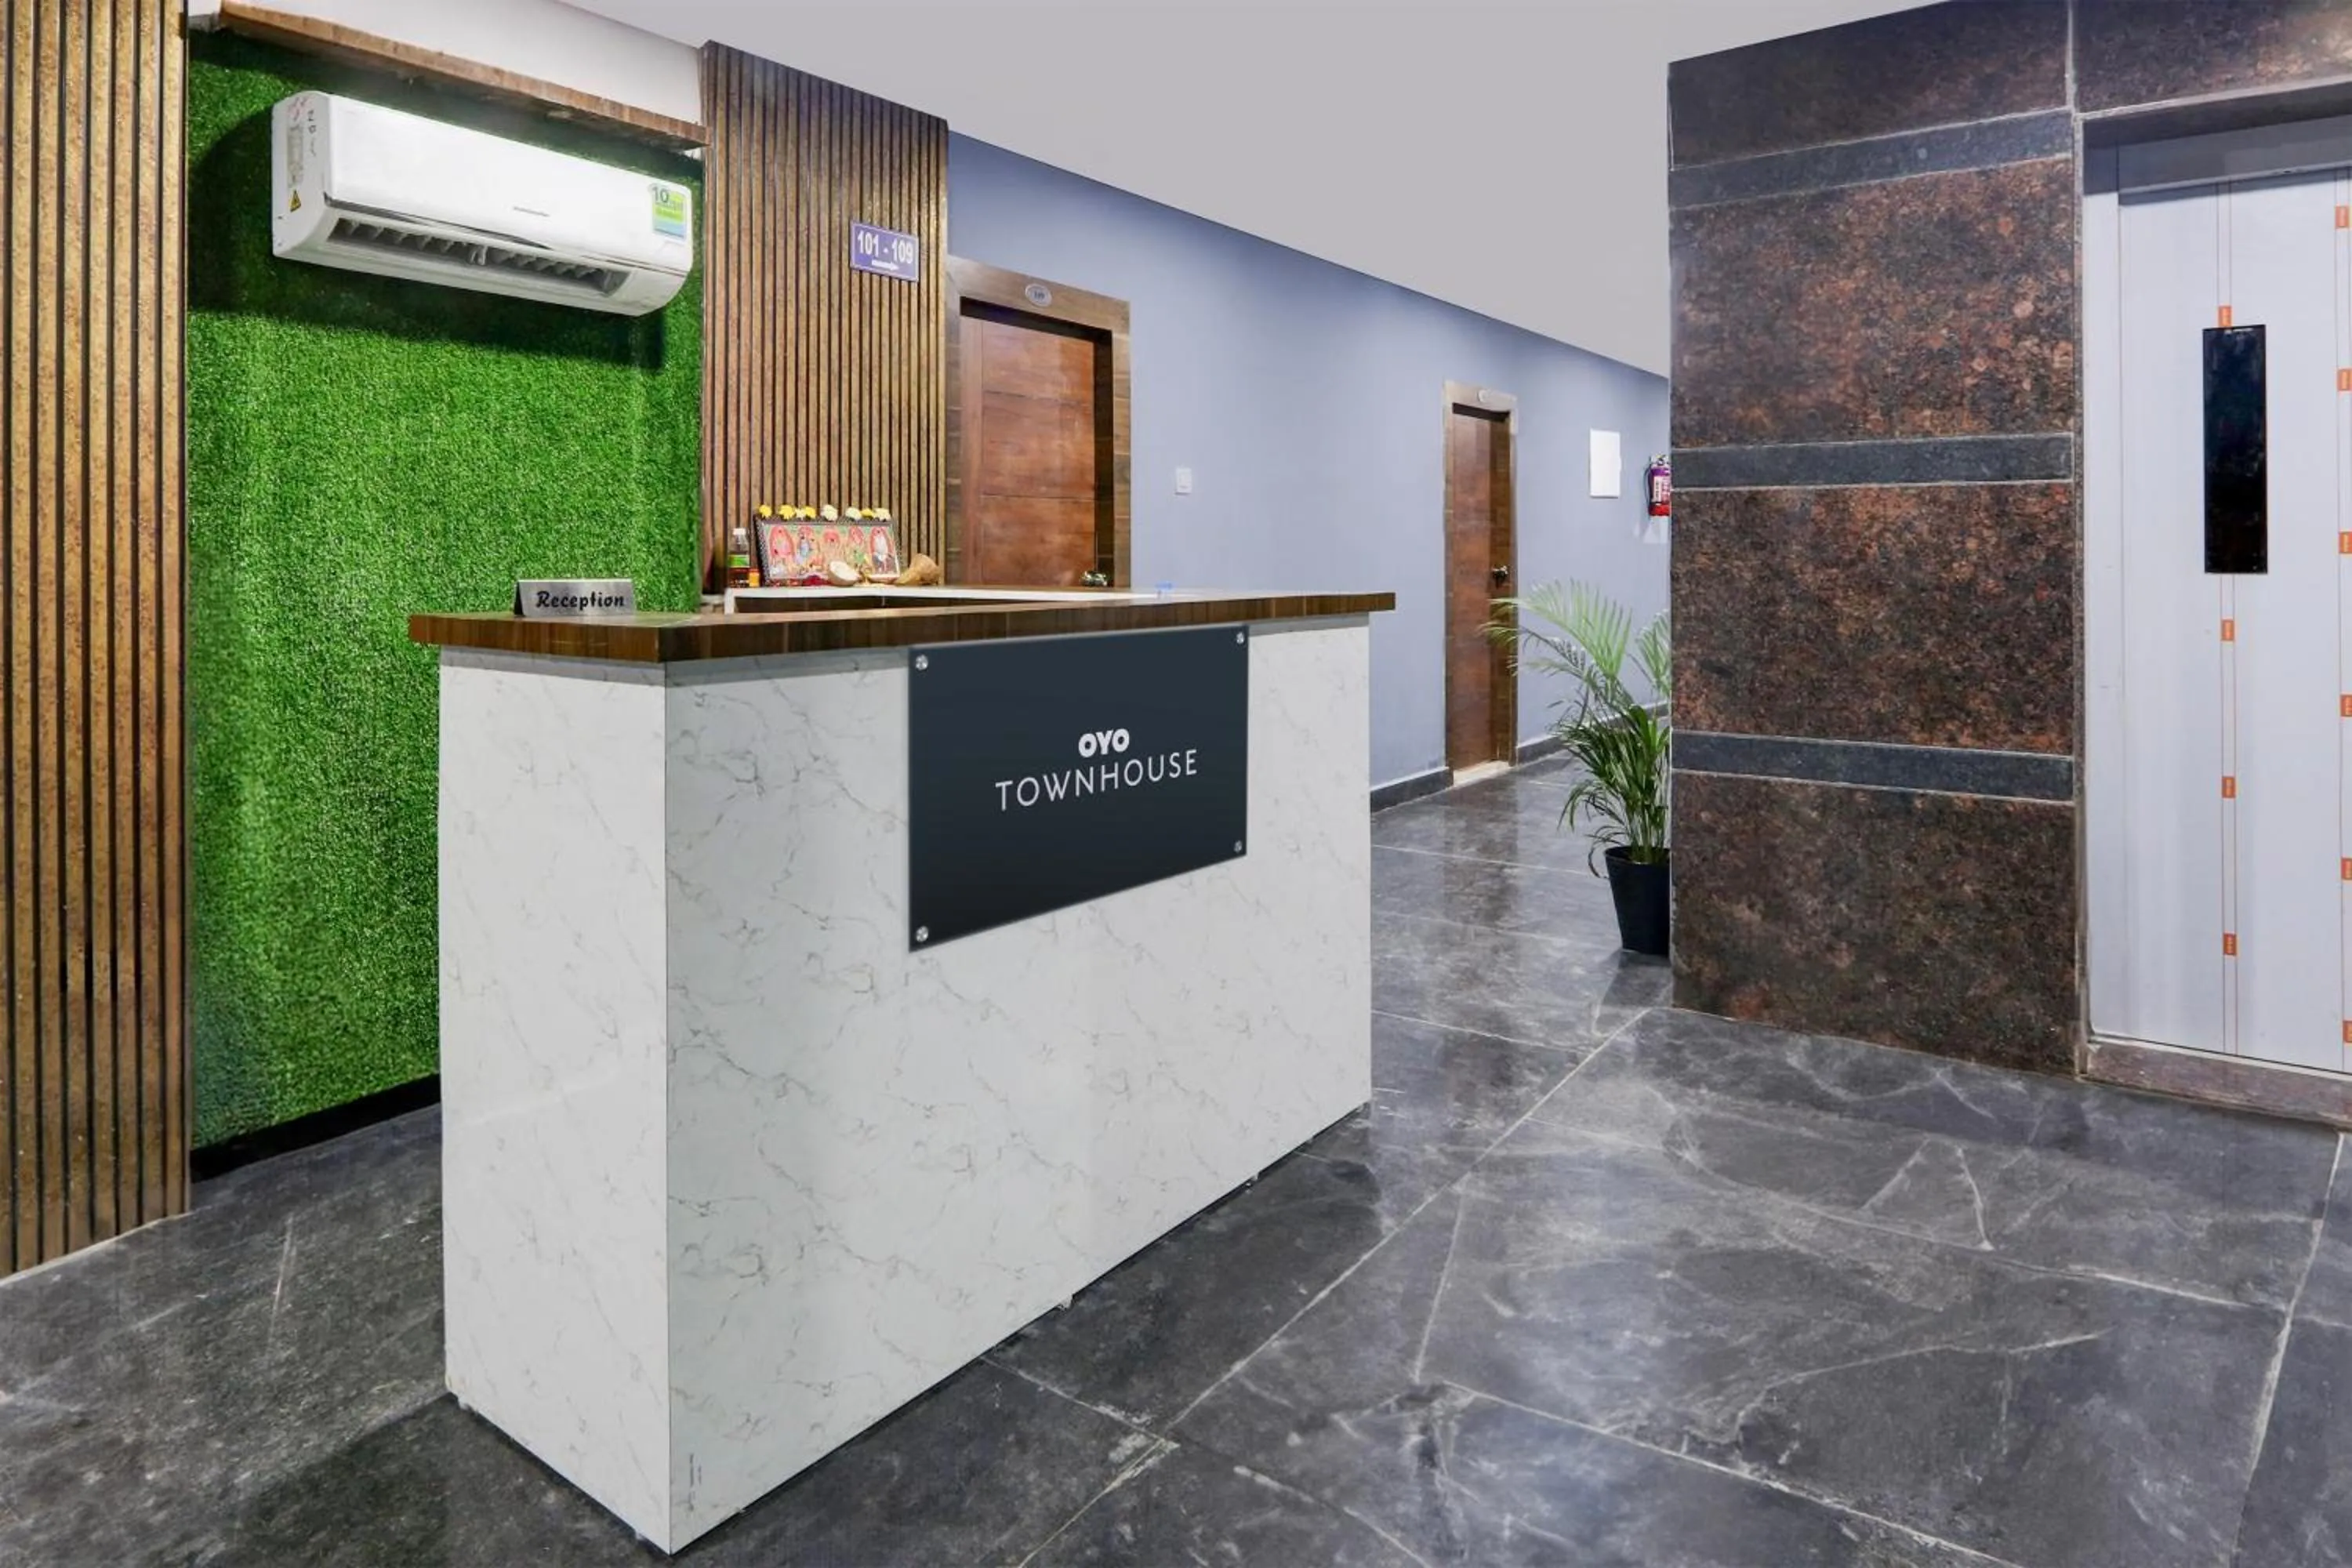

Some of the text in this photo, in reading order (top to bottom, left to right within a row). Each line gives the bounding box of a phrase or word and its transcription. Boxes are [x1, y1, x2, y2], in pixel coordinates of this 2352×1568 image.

[857, 230, 879, 259] 101
[891, 238, 913, 264] 109
[535, 590, 625, 611] Reception
[1078, 728, 1130, 758] OYO
[995, 749, 1197, 811] TOWNHOUSE
